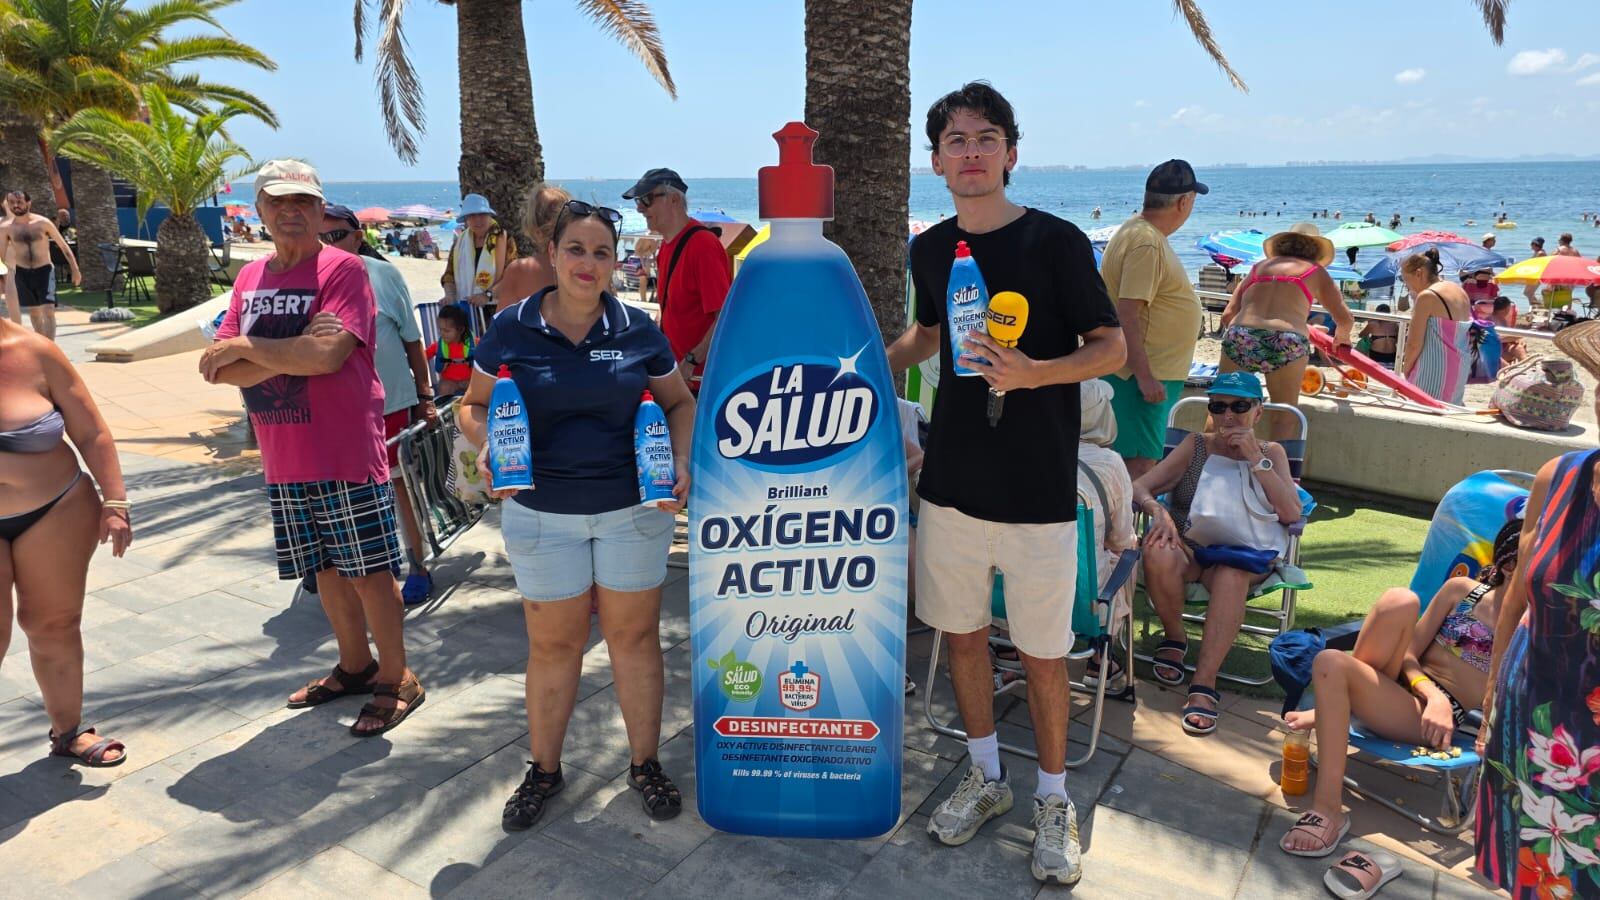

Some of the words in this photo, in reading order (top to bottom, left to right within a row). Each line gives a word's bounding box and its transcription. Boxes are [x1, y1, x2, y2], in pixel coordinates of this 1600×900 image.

[953, 288, 979, 305] SALUD
[240, 295, 316, 315] DESERT
[953, 311, 986, 324] OXÍGENO
[986, 308, 1017, 326] SER
[957, 322, 984, 333] ACTIVO
[589, 350, 624, 361] SER
[770, 365, 803, 395] LA
[495, 404, 521, 419] SALUD
[645, 425, 667, 436] SALUD
[718, 387, 873, 459] SALUD
[494, 427, 527, 438] OXÍGENO
[497, 436, 525, 446] ACTIVO
[767, 485, 829, 500] Brilliant
[700, 504, 896, 550] OXÍGENO
[717, 555, 877, 596] ACTIVO
[746, 608, 855, 641] Original
[724, 670, 758, 685] SALUD
[728, 720, 864, 737] DESINFECTANTE
[716, 742, 736, 750] OXY
[736, 742, 768, 751] ACTIVE
[769, 743, 833, 753] DISINFECTANT
[833, 745, 877, 754] CLEANER
[721, 753, 789, 763] DESINFETANTE
[790, 755, 843, 765] OXIGENADO
[843, 757, 872, 766] ATIVO
[732, 769, 749, 777] Kills
[751, 769, 772, 778] 99.99
[783, 770, 791, 778] of
[793, 770, 820, 779] viruses
[829, 771, 861, 780] bacteria
